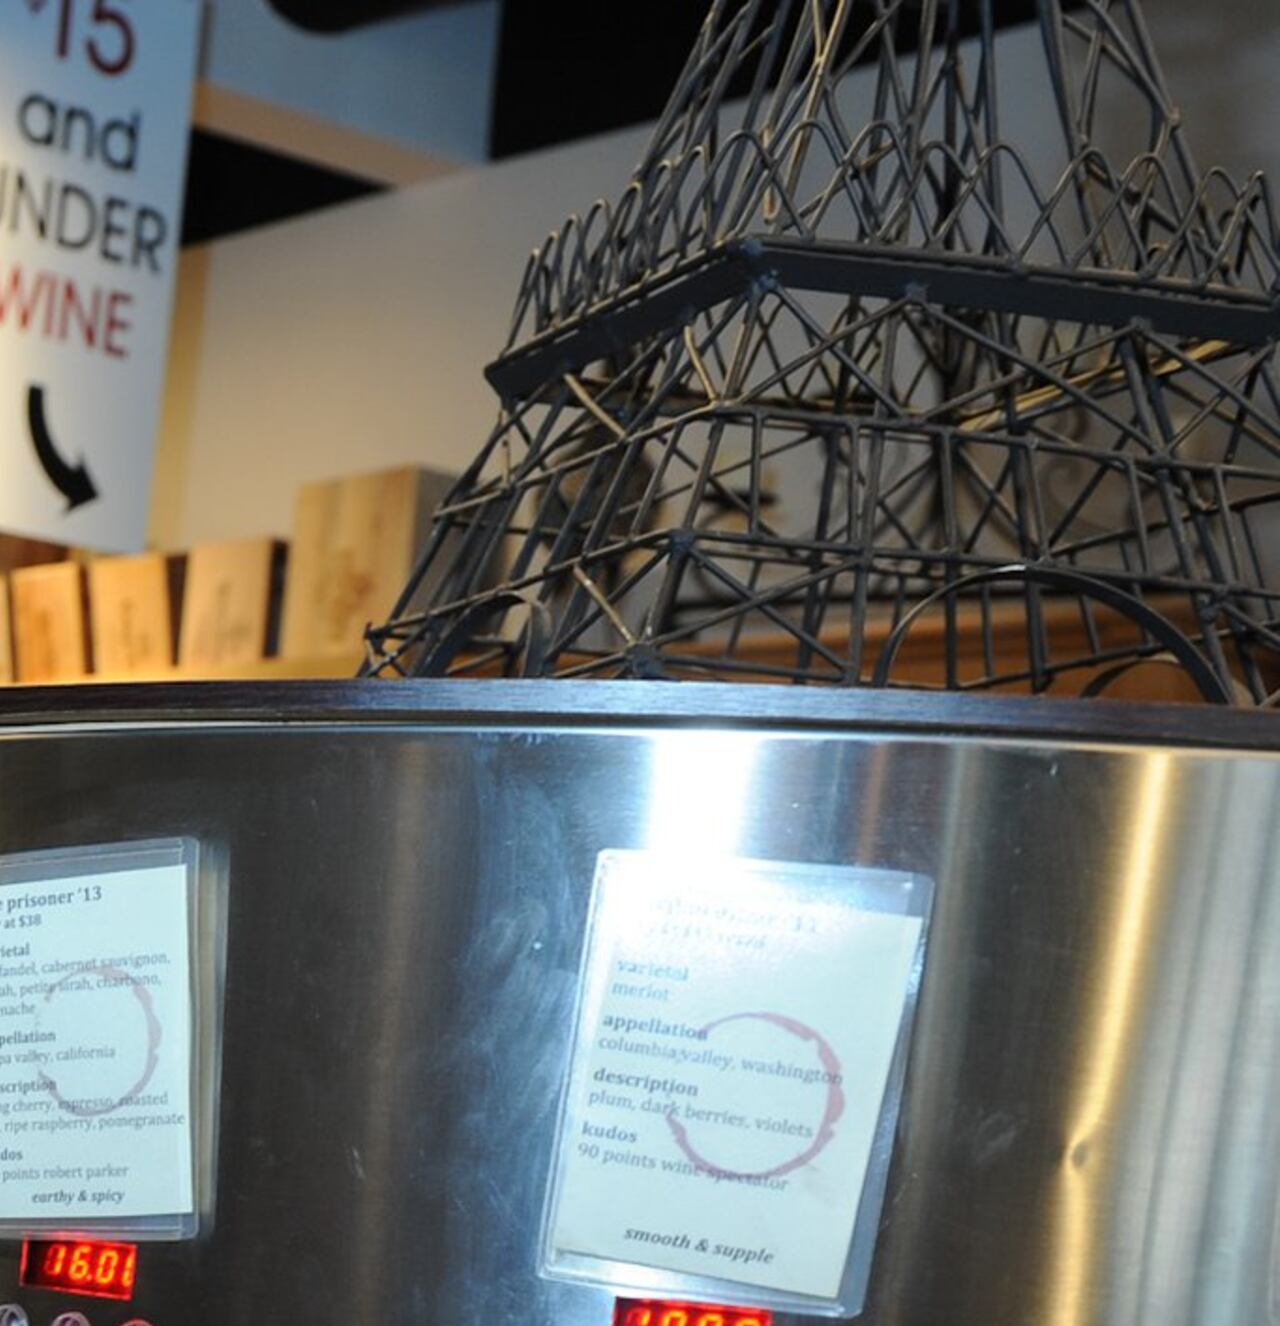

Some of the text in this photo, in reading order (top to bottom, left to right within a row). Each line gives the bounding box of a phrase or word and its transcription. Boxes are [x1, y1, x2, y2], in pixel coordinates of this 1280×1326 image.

[17, 93, 142, 173] and
[6, 892, 75, 914] prisoner
[4, 916, 16, 930] at
[41, 957, 98, 974] cabernet
[616, 957, 690, 982] varietal
[610, 981, 671, 1002] merlot
[601, 1011, 708, 1042] appellation
[56, 1046, 117, 1062] california
[592, 1067, 699, 1097] description
[740, 1057, 844, 1086] washington
[12, 1098, 55, 1114] cherry,
[119, 1092, 169, 1107] roasted
[4, 1118, 30, 1135] ripe
[99, 1113, 186, 1131] pomegranate
[588, 1089, 636, 1112] plum,
[640, 1095, 681, 1117] dark
[754, 1115, 814, 1140] violets
[581, 1121, 638, 1144] kudos
[2, 1167, 41, 1183] points
[43, 1165, 83, 1180] robert
[87, 1163, 130, 1180] parker
[578, 1141, 790, 1192] 90 points wine spectator
[31, 1188, 126, 1206] earthy & spicy
[623, 1225, 775, 1266] smooth & supple
